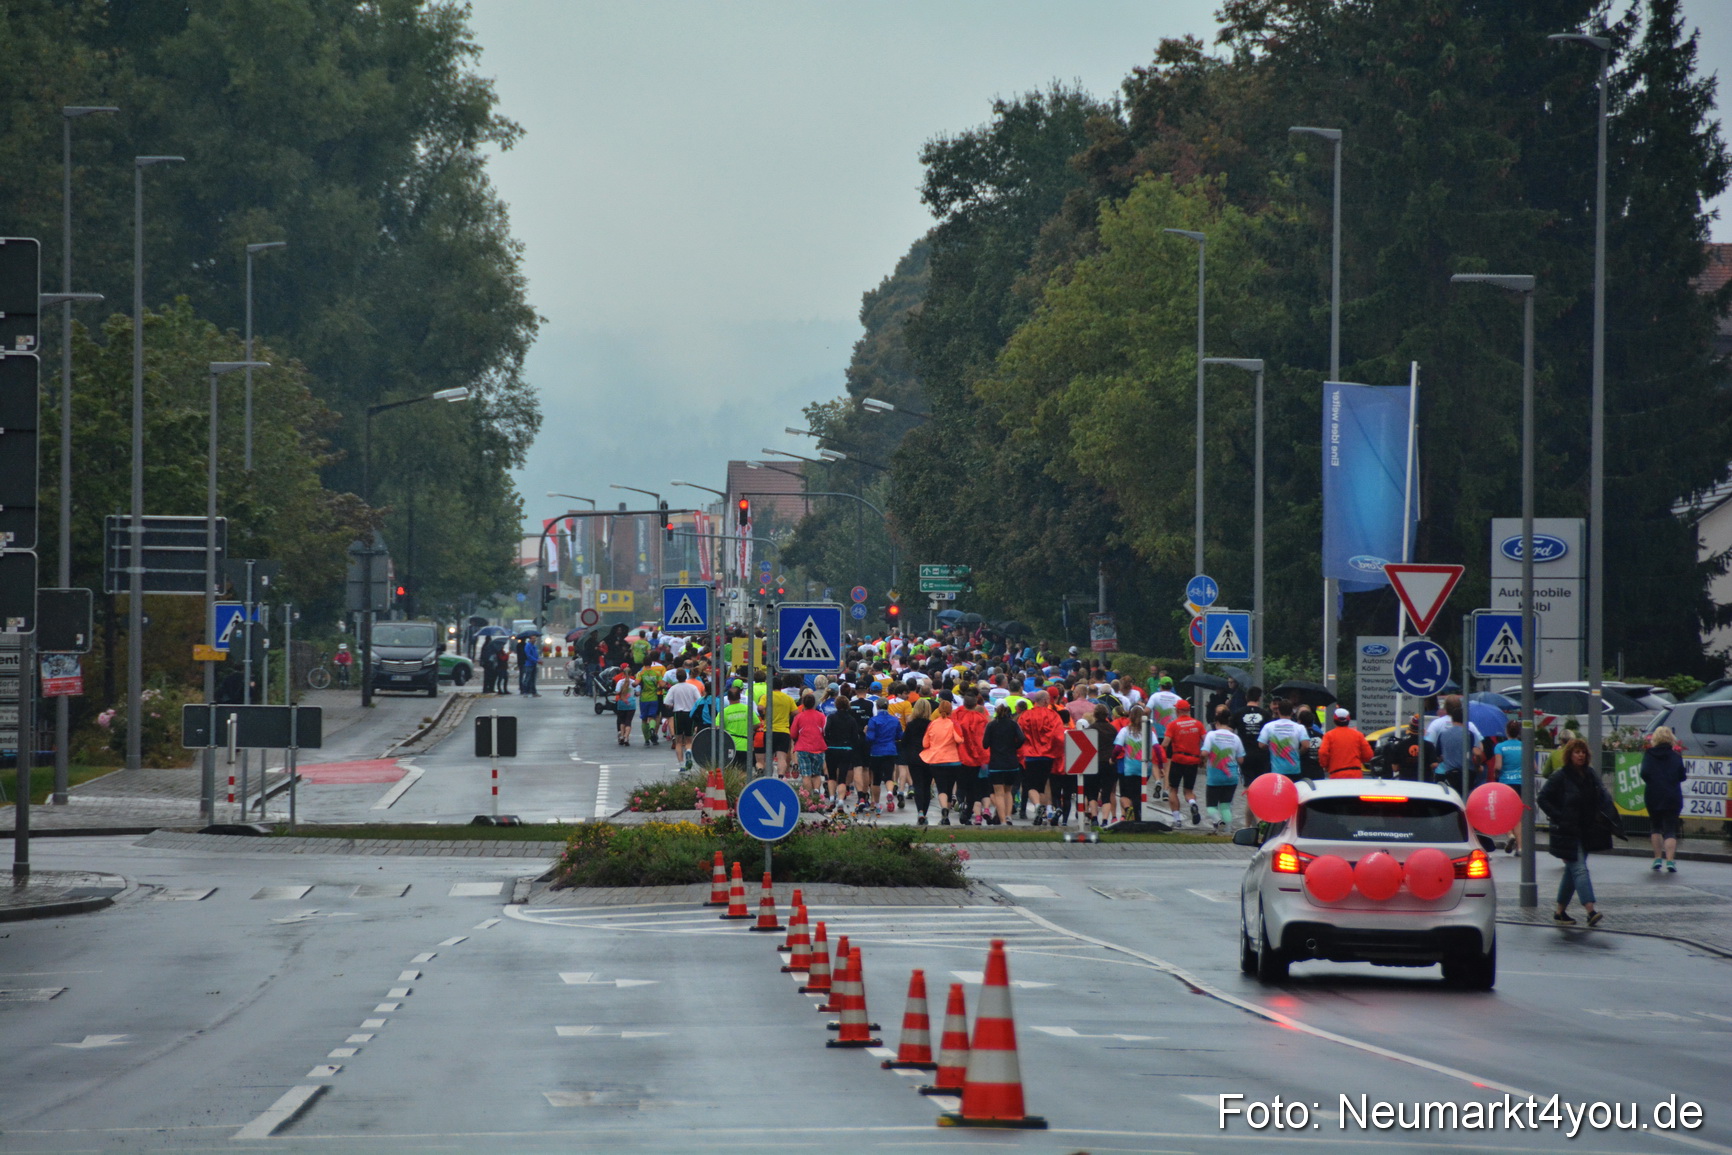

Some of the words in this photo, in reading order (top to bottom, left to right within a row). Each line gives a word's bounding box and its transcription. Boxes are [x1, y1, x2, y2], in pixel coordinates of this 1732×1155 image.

[1513, 539, 1554, 557] Frd
[1498, 587, 1572, 598] Autmobile
[1518, 602, 1551, 612] lbl
[1709, 761, 1724, 775] NR
[1691, 780, 1728, 795] 40000
